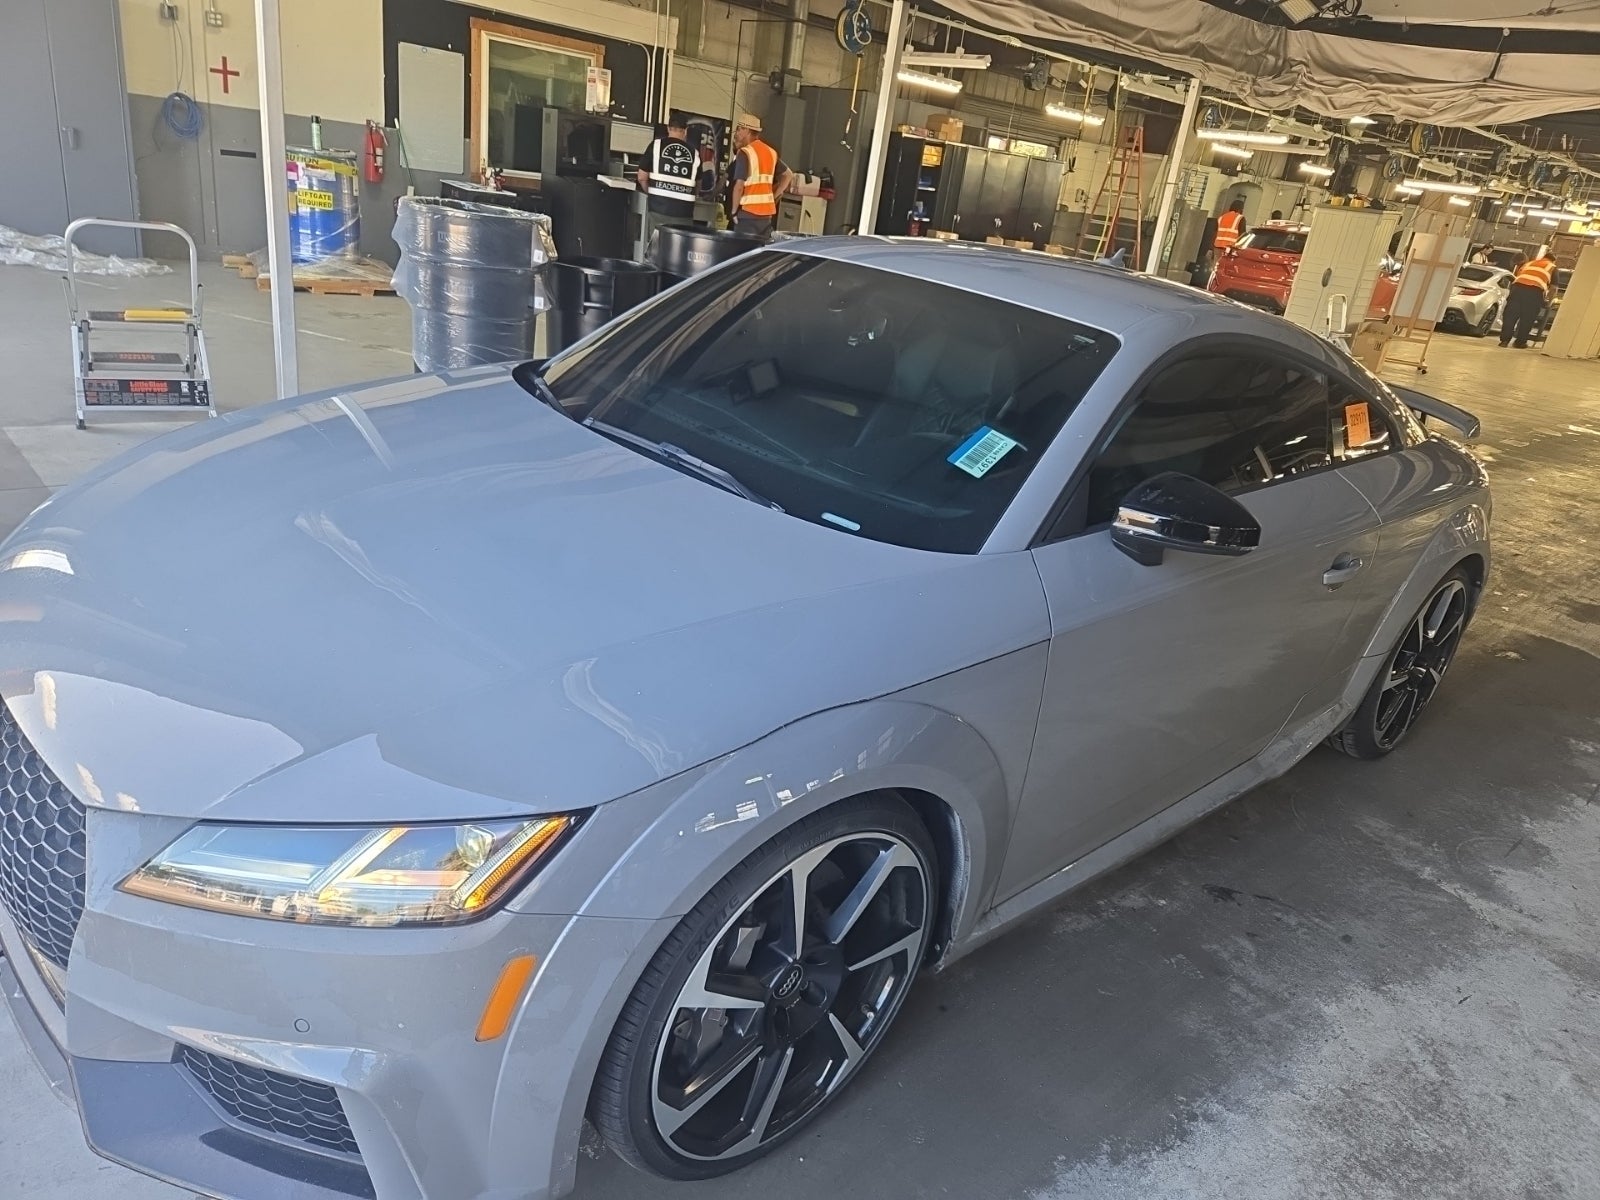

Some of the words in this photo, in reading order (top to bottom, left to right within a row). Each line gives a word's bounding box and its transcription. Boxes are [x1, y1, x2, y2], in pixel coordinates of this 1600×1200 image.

[664, 163, 688, 176] RSO
[298, 191, 331, 201] LIFTGATE
[298, 199, 332, 208] REQUIRED
